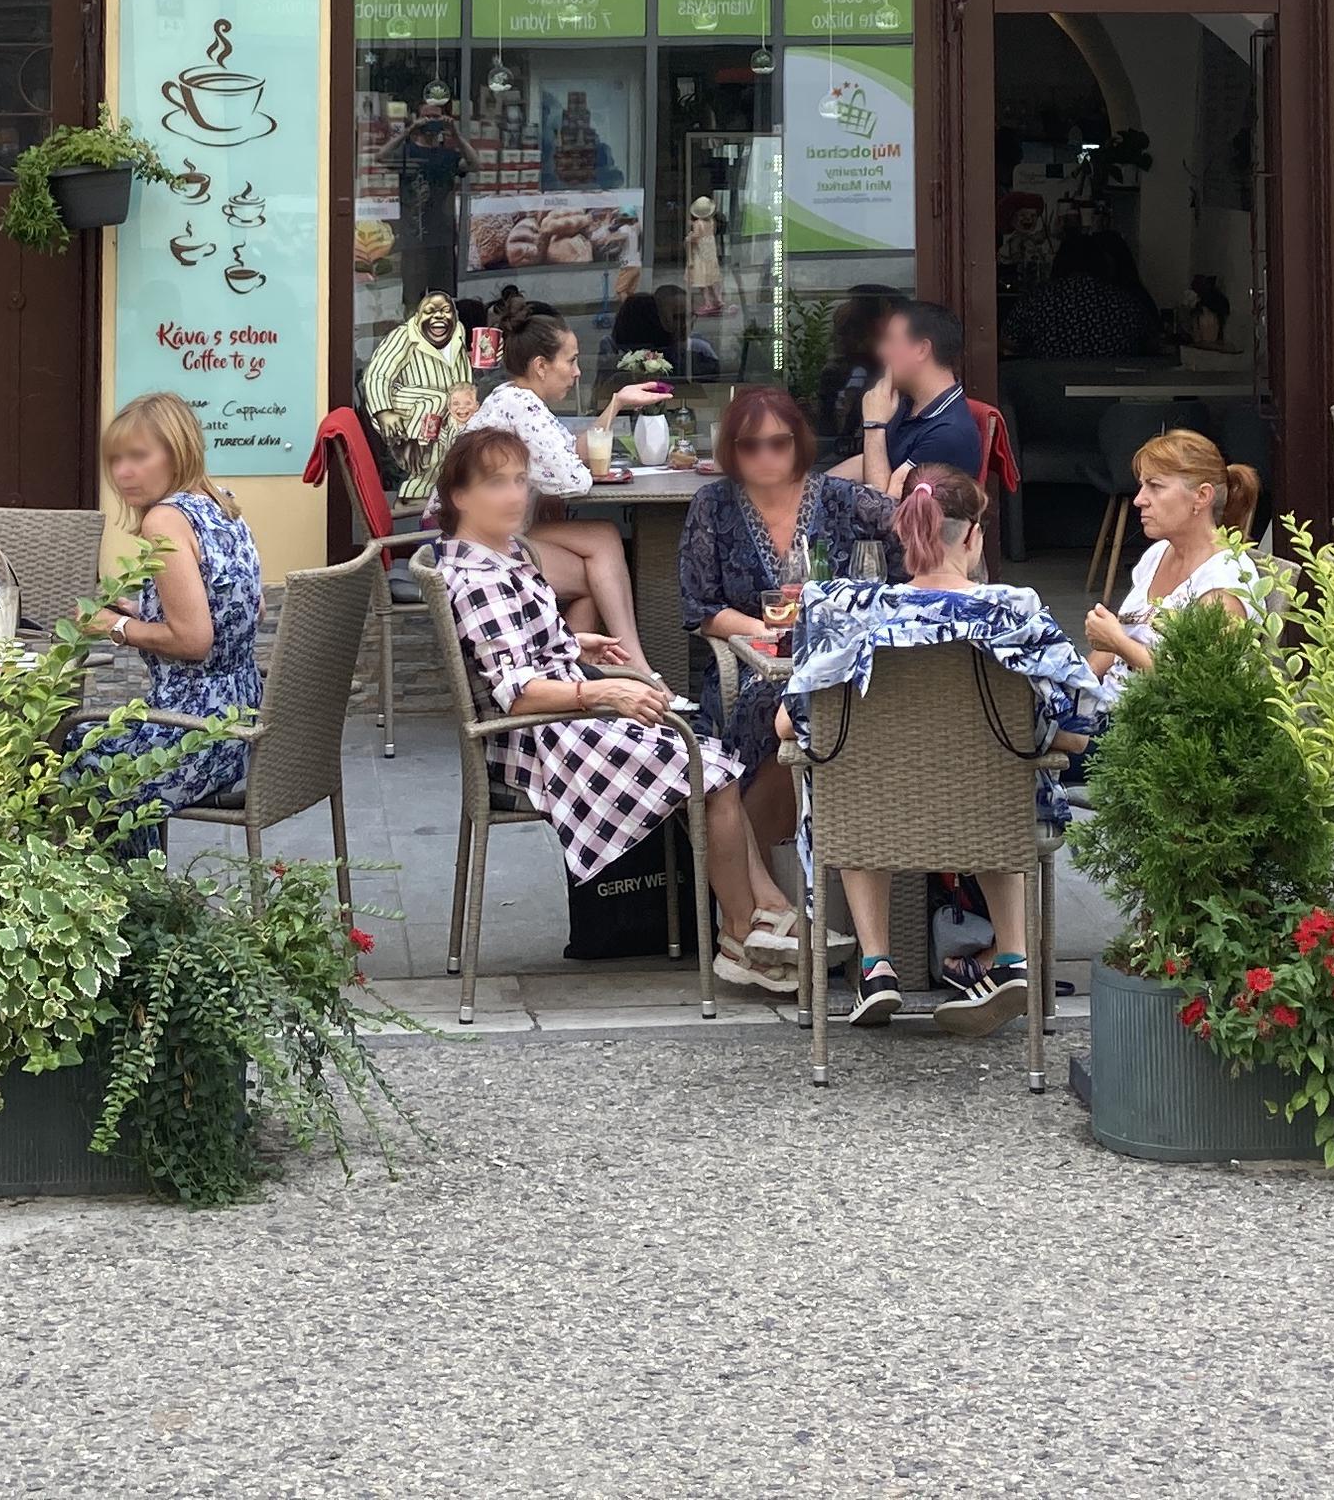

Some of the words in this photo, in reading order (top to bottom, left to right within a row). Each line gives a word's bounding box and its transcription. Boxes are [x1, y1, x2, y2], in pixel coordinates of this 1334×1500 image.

[156, 321, 210, 350] Káva
[214, 329, 223, 346] s
[229, 325, 278, 346] sebou
[183, 348, 227, 372] Coffee
[230, 351, 245, 369] to
[244, 357, 266, 380] go
[222, 400, 287, 421] Cappuccino
[214, 435, 256, 449] TURECKÁ
[258, 435, 281, 446] KÁVA
[597, 876, 643, 897] GERRY
